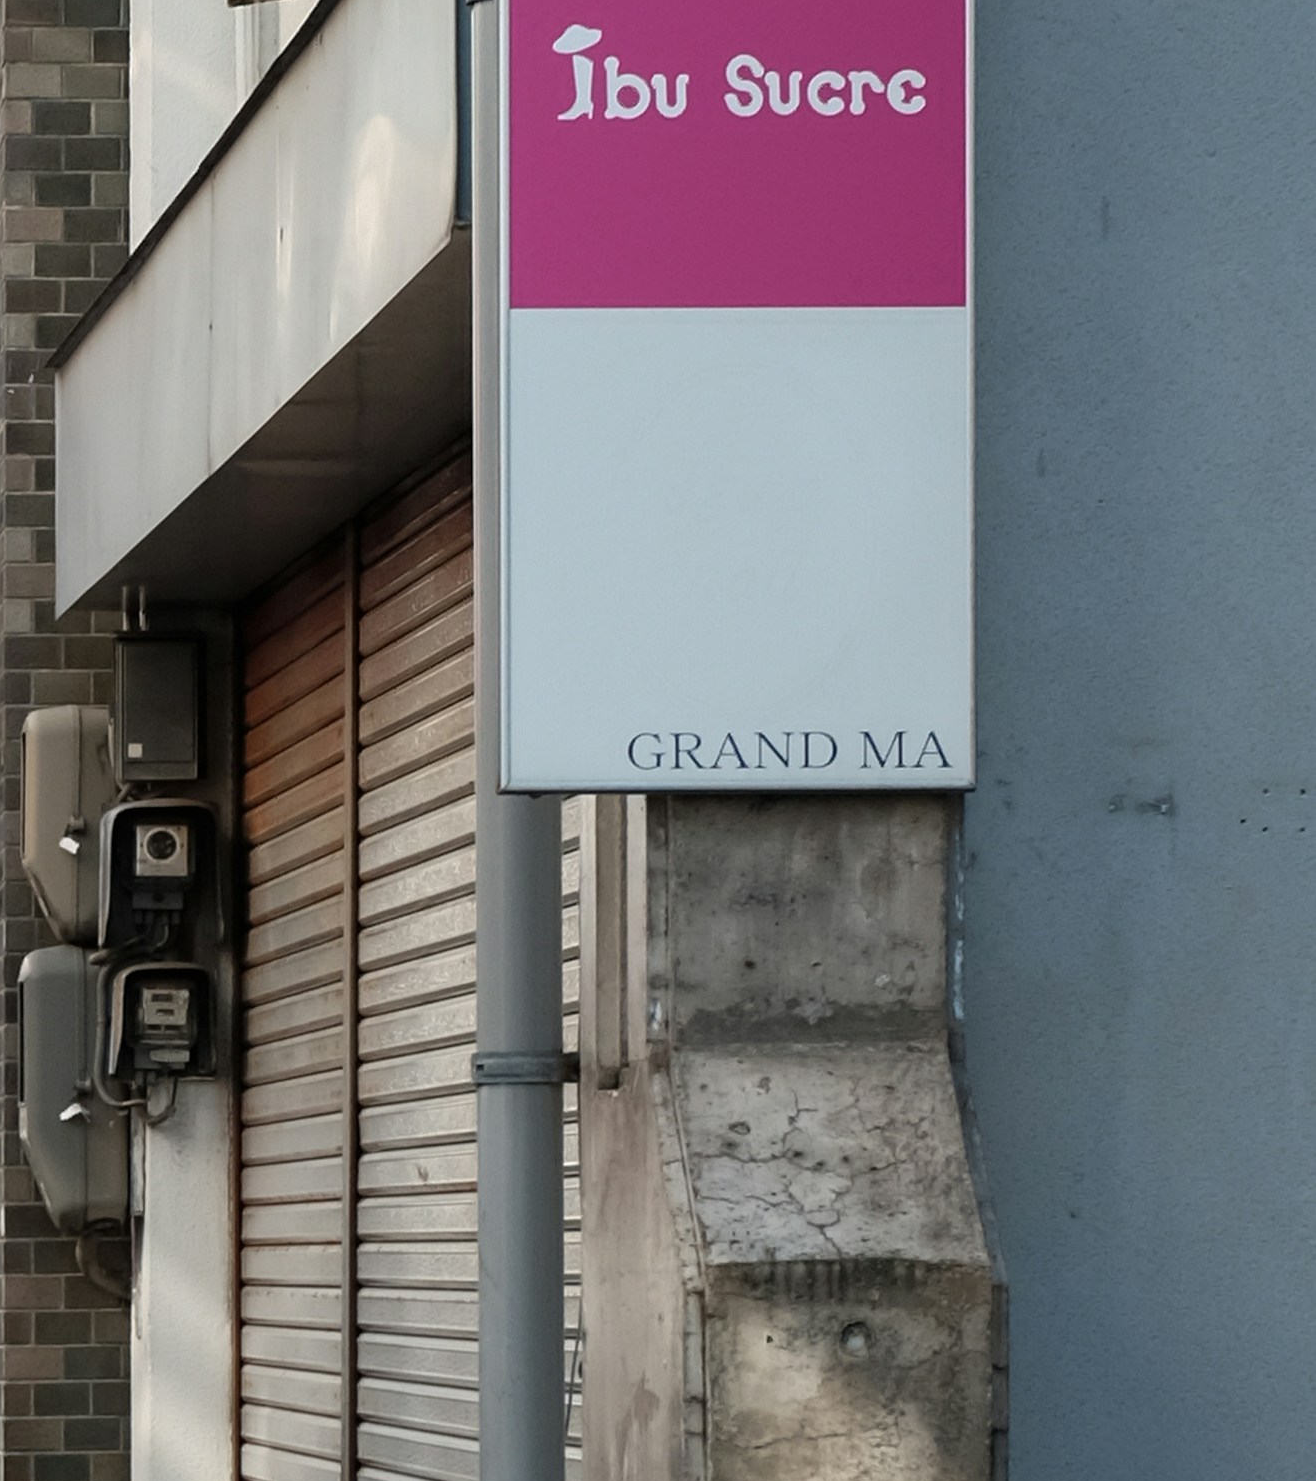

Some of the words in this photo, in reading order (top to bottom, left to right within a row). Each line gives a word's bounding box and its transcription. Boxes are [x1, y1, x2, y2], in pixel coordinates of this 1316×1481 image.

[725, 53, 928, 119] Sucre
[626, 729, 839, 771] GRAND
[860, 729, 953, 771] MA
